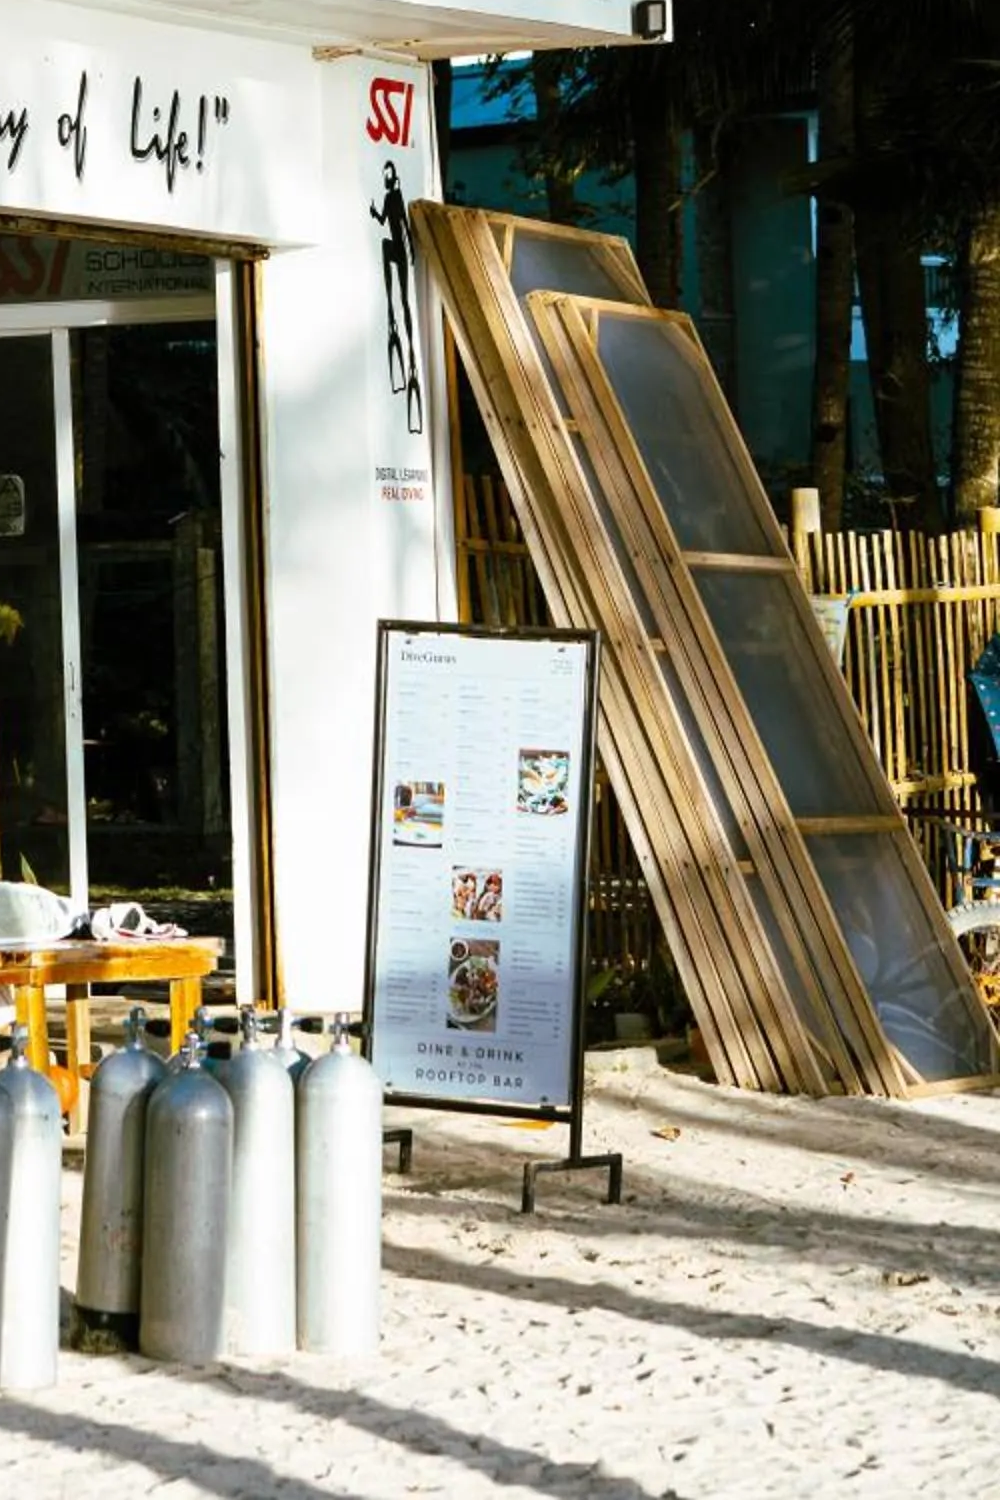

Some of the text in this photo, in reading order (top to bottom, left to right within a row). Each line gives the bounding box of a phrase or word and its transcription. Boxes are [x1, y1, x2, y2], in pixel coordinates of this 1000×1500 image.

[57, 70, 88, 181] of
[366, 77, 414, 147] SSI
[417, 1043, 524, 1062] DINE & DRINK
[415, 1067, 524, 1088] ROOFTOP BAR
